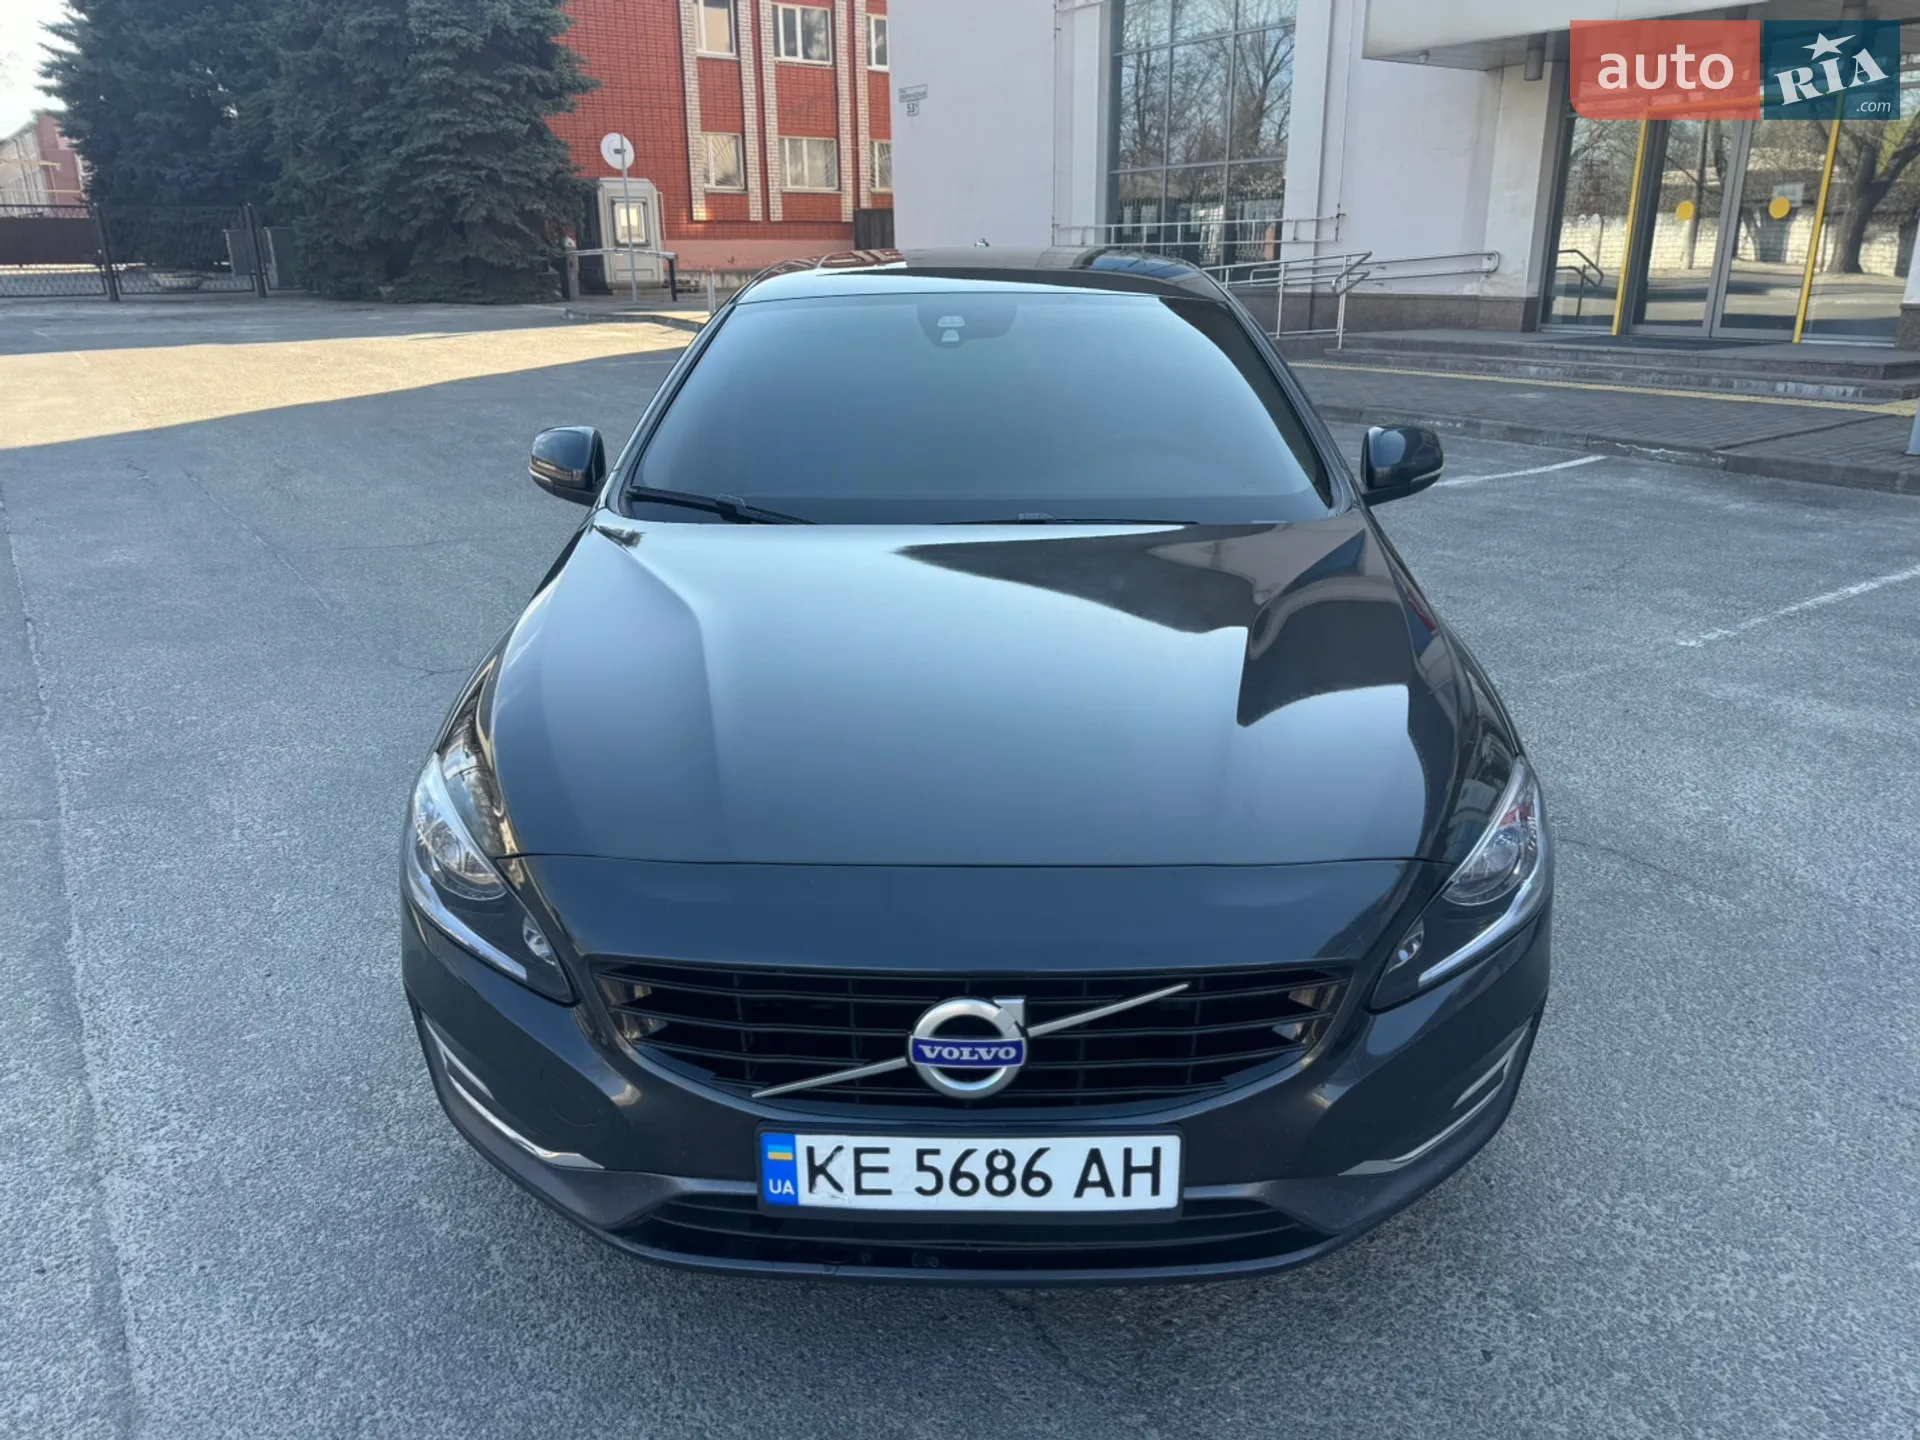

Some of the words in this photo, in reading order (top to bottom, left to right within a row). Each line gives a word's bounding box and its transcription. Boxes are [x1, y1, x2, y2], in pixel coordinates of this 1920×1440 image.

[918, 1045, 1017, 1060] VOLVO
[805, 1144, 893, 1197] KE
[914, 1146, 1054, 1198] 5686
[1072, 1146, 1163, 1199] AH
[768, 1179, 796, 1196] UA
